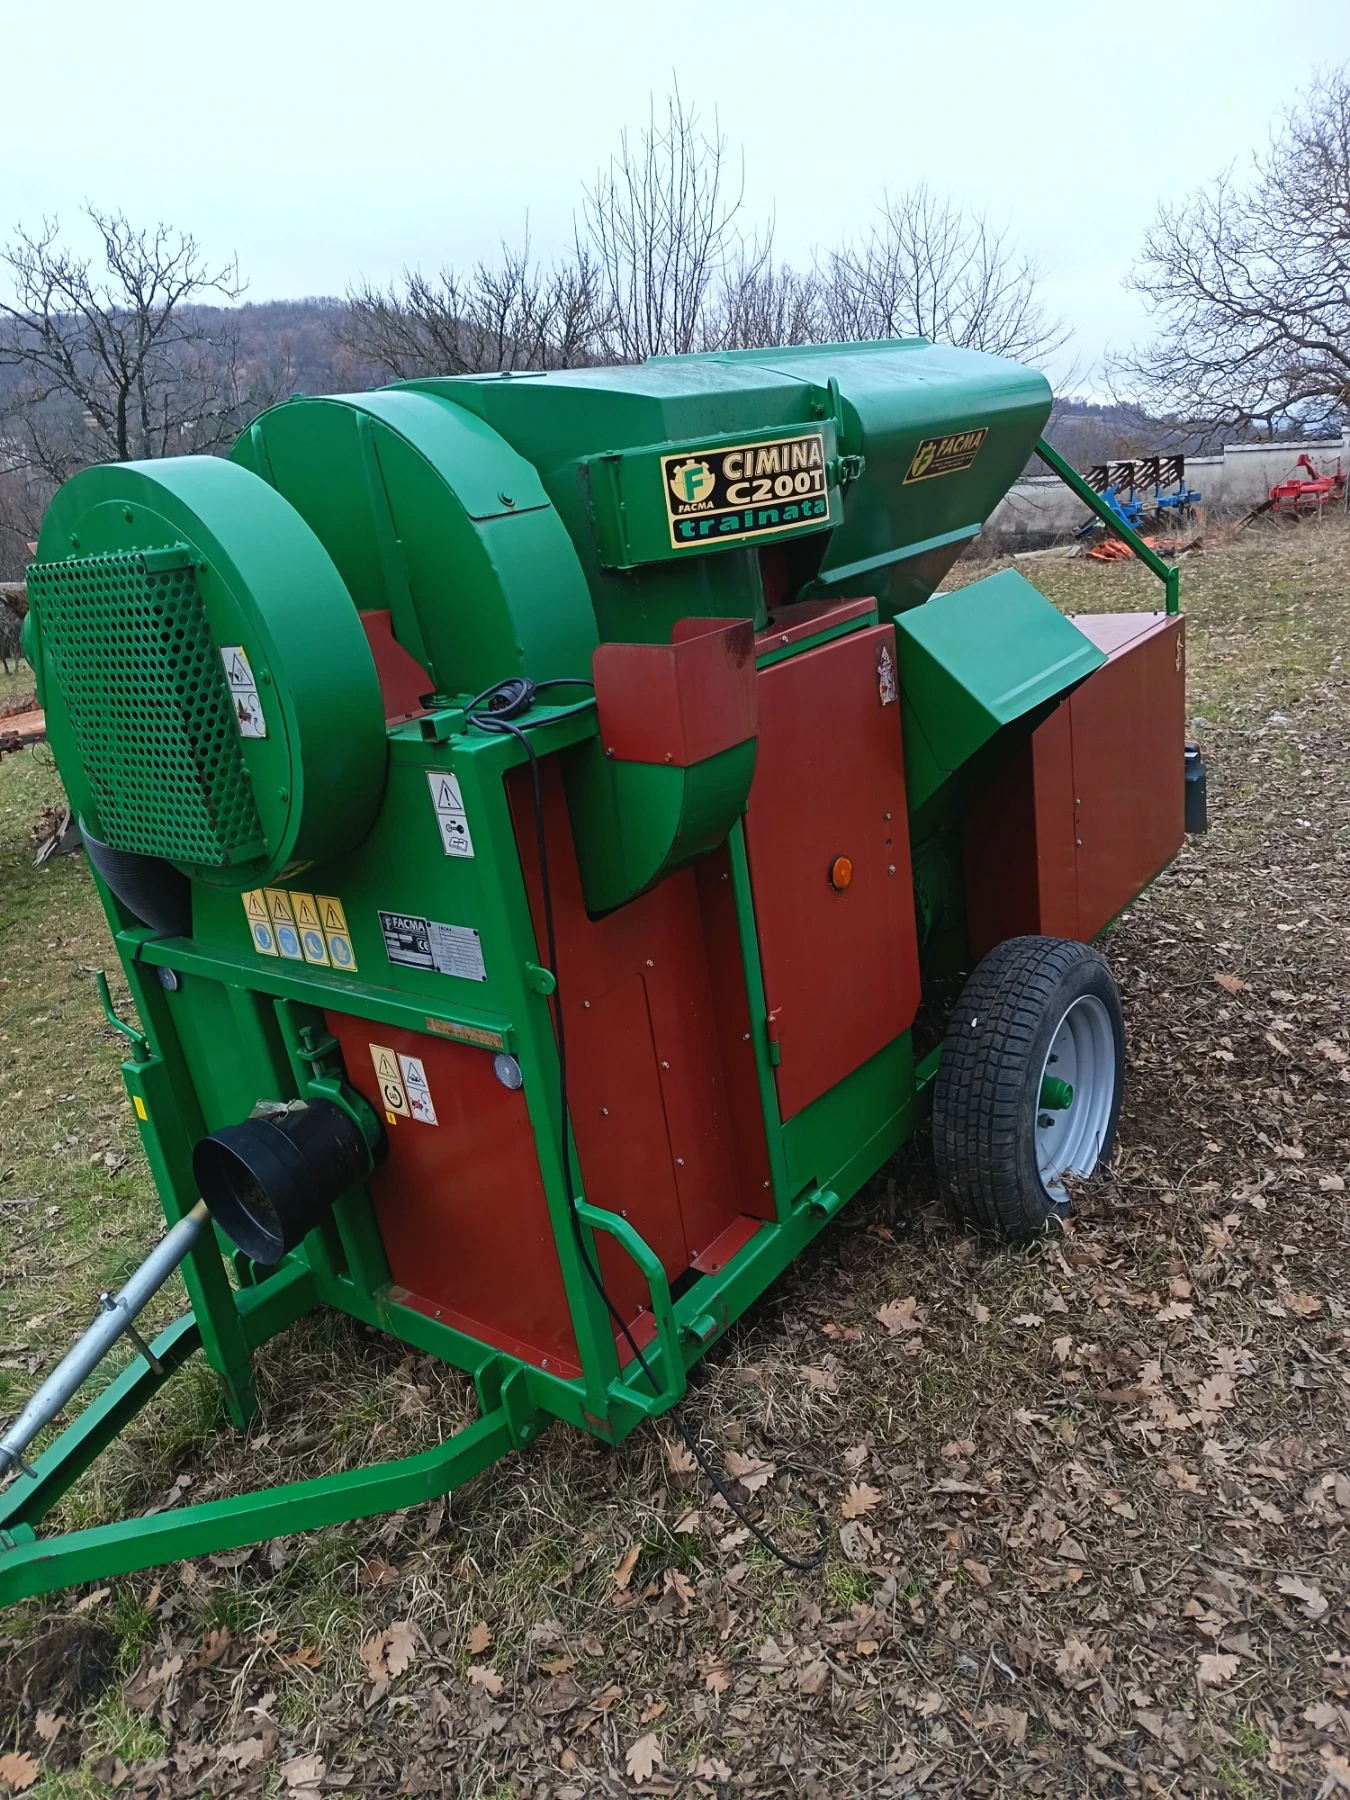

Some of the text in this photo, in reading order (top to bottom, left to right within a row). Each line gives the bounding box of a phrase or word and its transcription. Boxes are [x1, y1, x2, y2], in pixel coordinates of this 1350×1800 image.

[936, 432, 982, 456] FACMA
[722, 441, 822, 480] CIMINA
[726, 470, 823, 504] C200T
[678, 501, 715, 513] FACMA
[679, 499, 825, 537] trainata
[392, 917, 425, 931] FACMA
